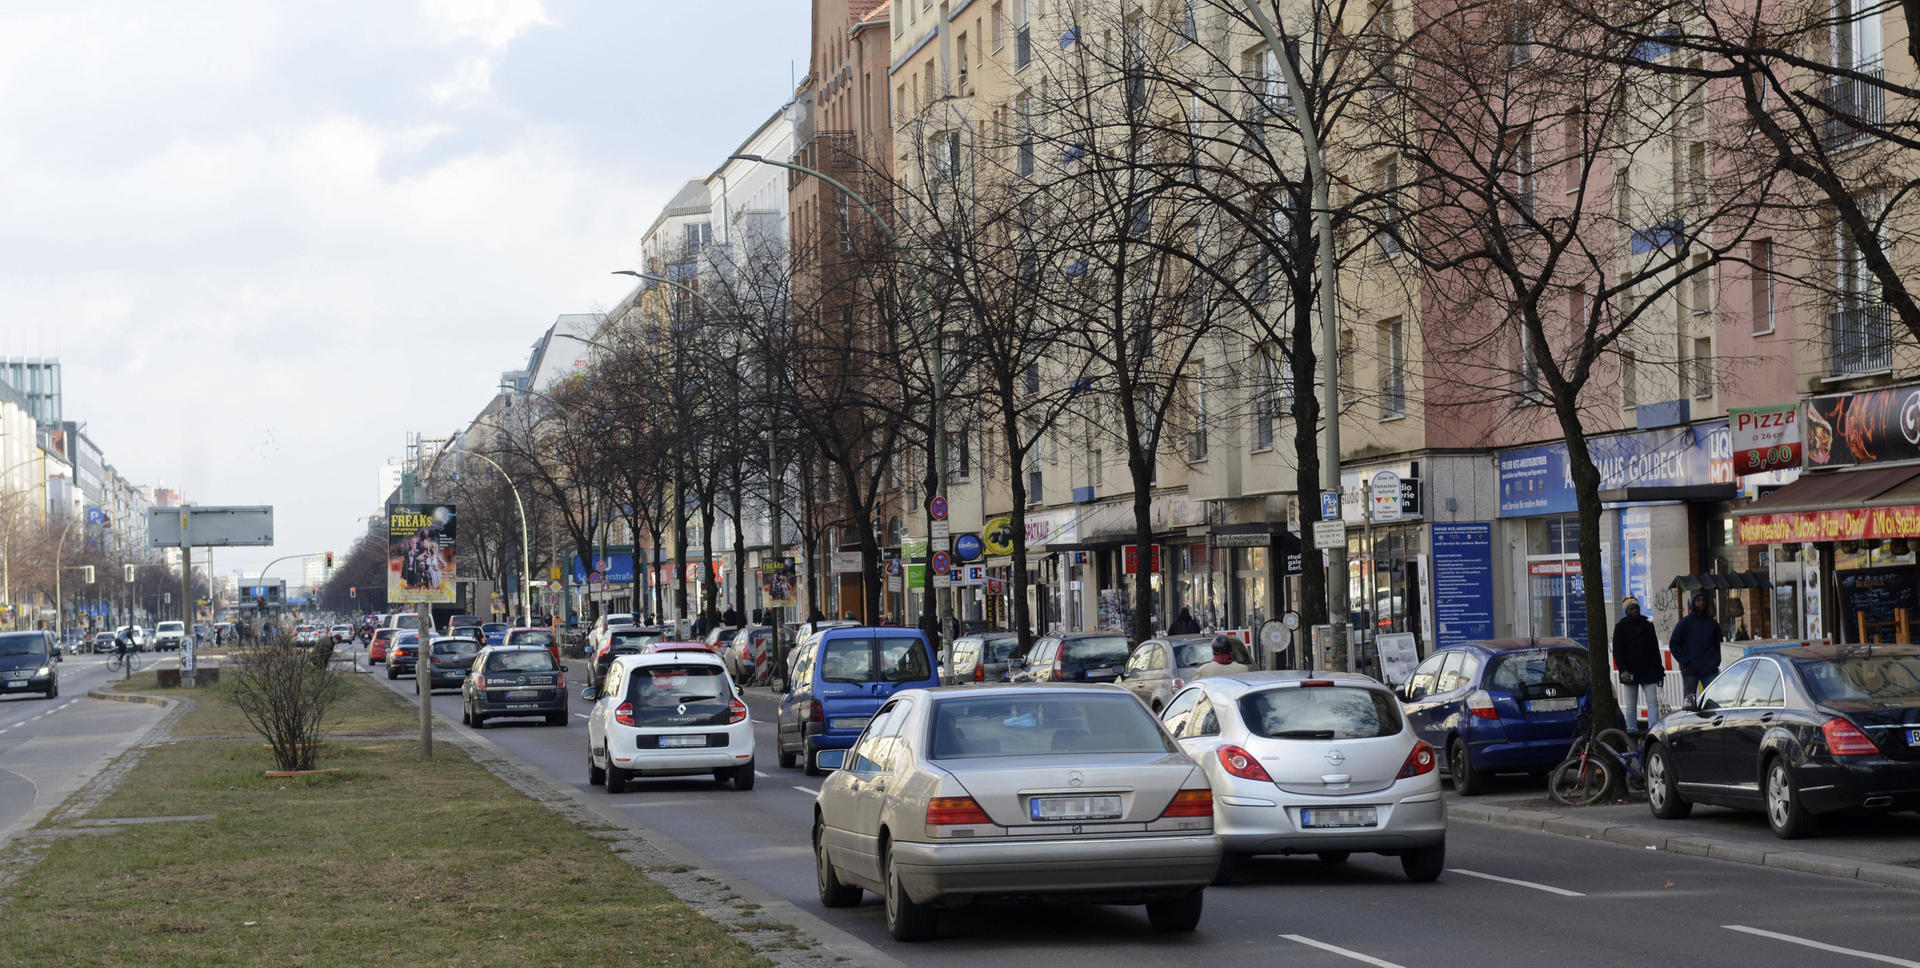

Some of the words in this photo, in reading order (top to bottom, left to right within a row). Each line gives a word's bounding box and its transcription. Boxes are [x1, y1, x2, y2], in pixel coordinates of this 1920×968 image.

[1738, 409, 1796, 432] Pizza
[1761, 432, 1772, 440] 26
[1747, 446, 1792, 468] 3,00
[1287, 553, 1302, 561] stud
